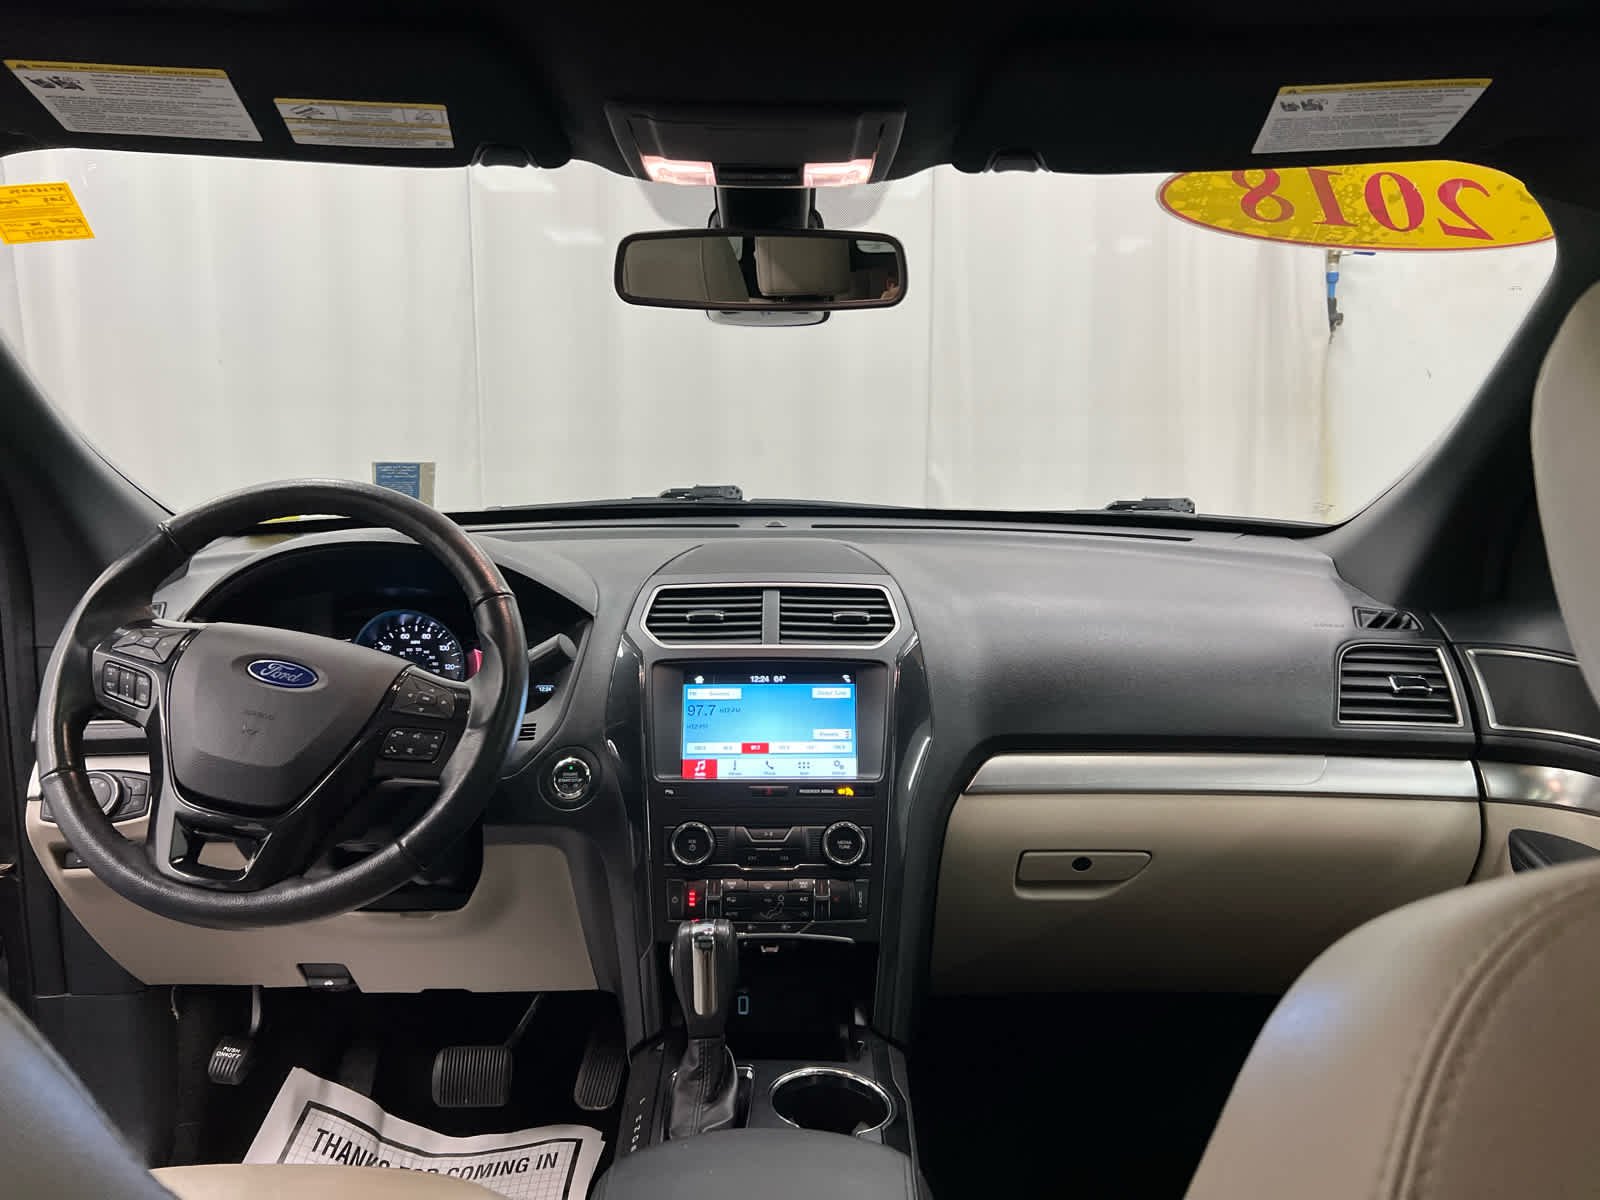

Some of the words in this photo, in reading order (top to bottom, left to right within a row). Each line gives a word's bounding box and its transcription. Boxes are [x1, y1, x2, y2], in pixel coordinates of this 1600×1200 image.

[260, 663, 304, 682] Ford
[751, 675, 770, 683] 12:24
[687, 704, 717, 717] 97.7
[223, 1046, 241, 1054] PUSH
[536, 1151, 559, 1170] IN
